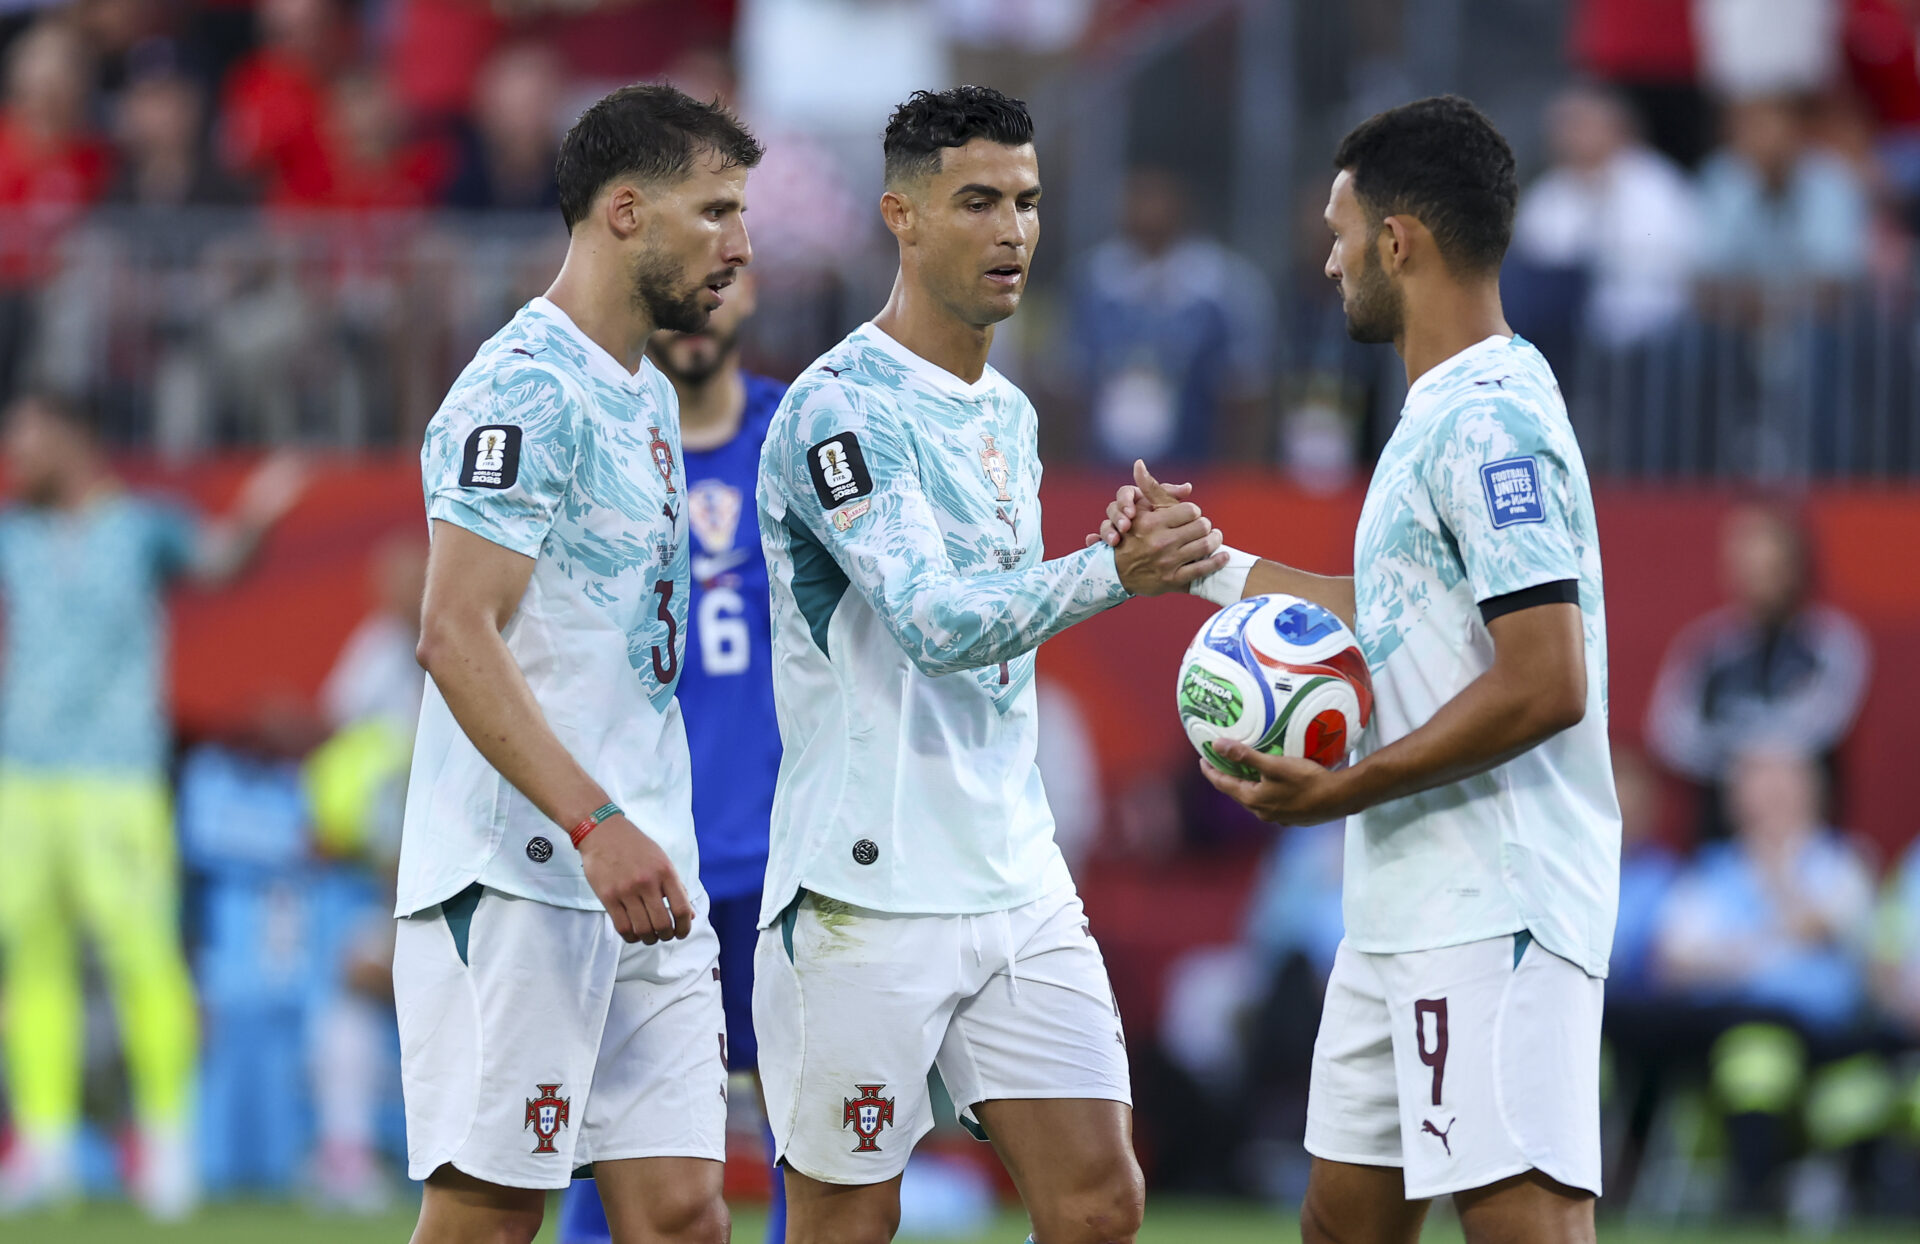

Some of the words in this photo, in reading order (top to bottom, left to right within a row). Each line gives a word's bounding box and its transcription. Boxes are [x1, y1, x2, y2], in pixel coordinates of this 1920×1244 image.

[471, 475, 501, 485] 2026
[1491, 467, 1530, 483] FOOTBALL
[833, 486, 859, 501] 2026
[1493, 478, 1532, 497] UNITES
[652, 579, 677, 684] 3
[698, 587, 750, 676] 6
[1415, 997, 1448, 1105] 9
